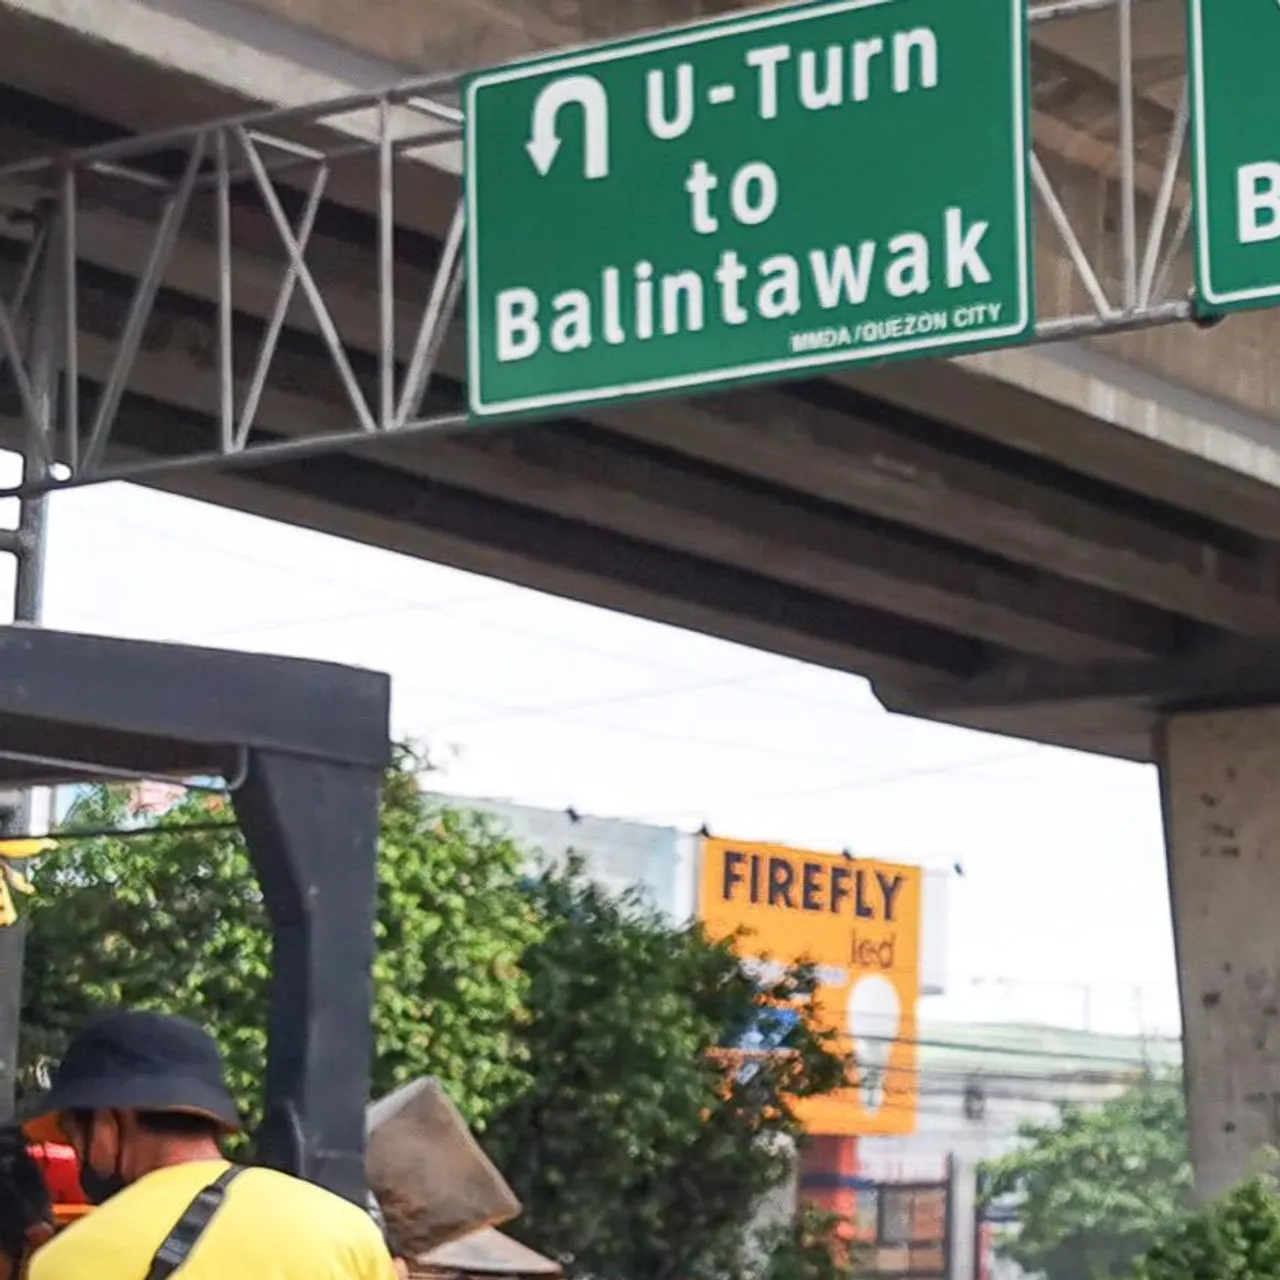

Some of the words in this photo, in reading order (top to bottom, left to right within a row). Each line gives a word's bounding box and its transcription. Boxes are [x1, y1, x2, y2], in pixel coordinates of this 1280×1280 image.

[646, 26, 938, 139] U-Turn
[685, 160, 777, 235] to
[497, 206, 992, 362] Balintawak
[953, 303, 1002, 328] CITY
[723, 850, 903, 921] FIREFLY
